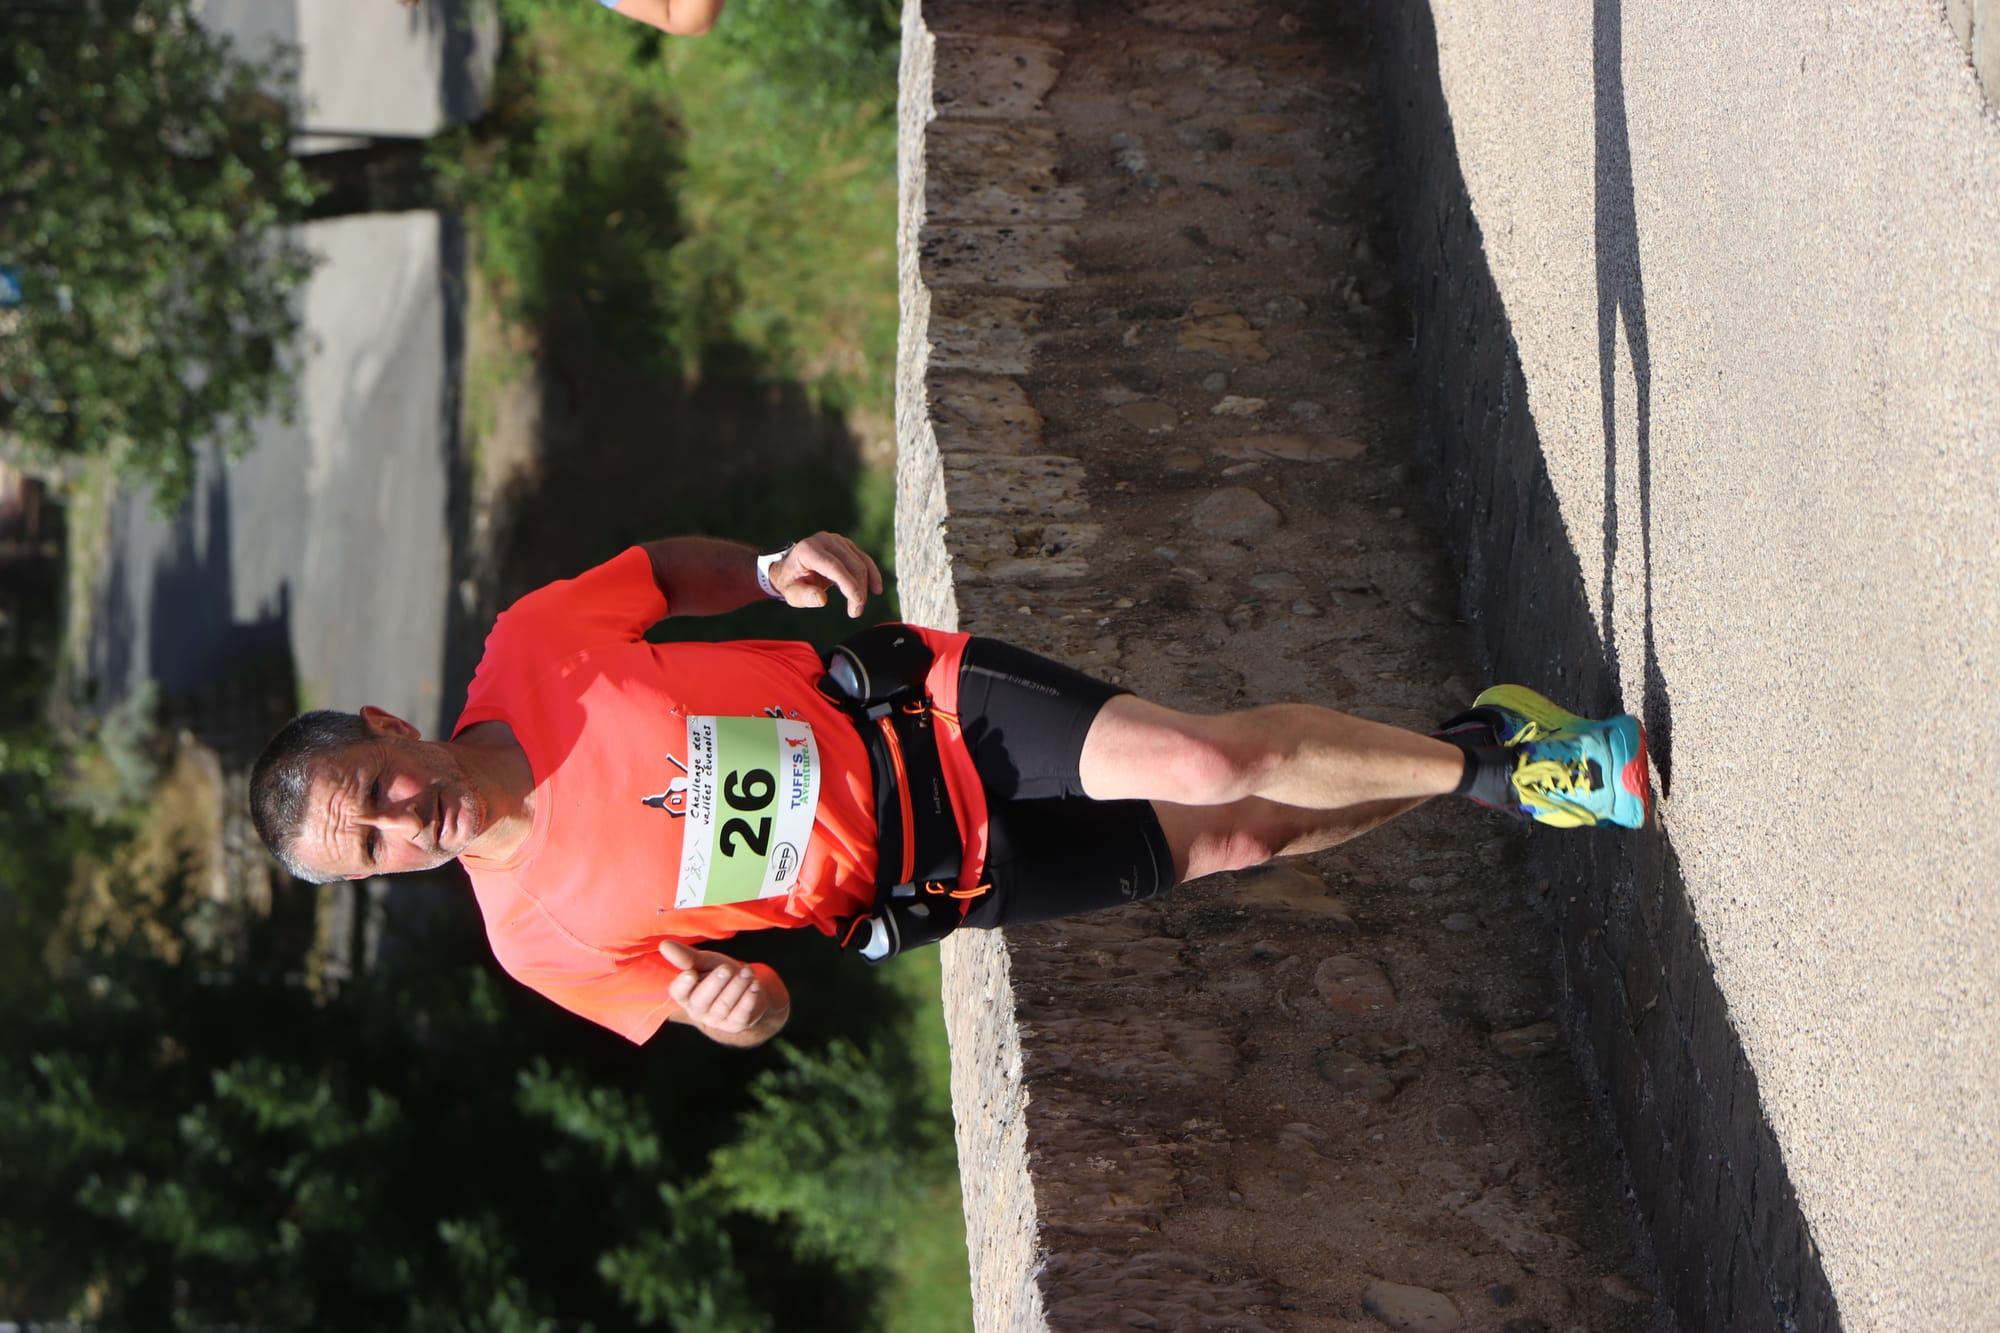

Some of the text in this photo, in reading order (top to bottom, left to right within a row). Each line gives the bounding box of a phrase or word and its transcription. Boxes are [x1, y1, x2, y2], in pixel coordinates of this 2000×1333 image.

[690, 730, 704, 819] Challenge des
[790, 753, 803, 810] TUFF'S
[799, 748, 810, 805] Aventure
[702, 784, 712, 825] vallées
[719, 768, 777, 859] 26
[774, 847, 791, 882] BFP
